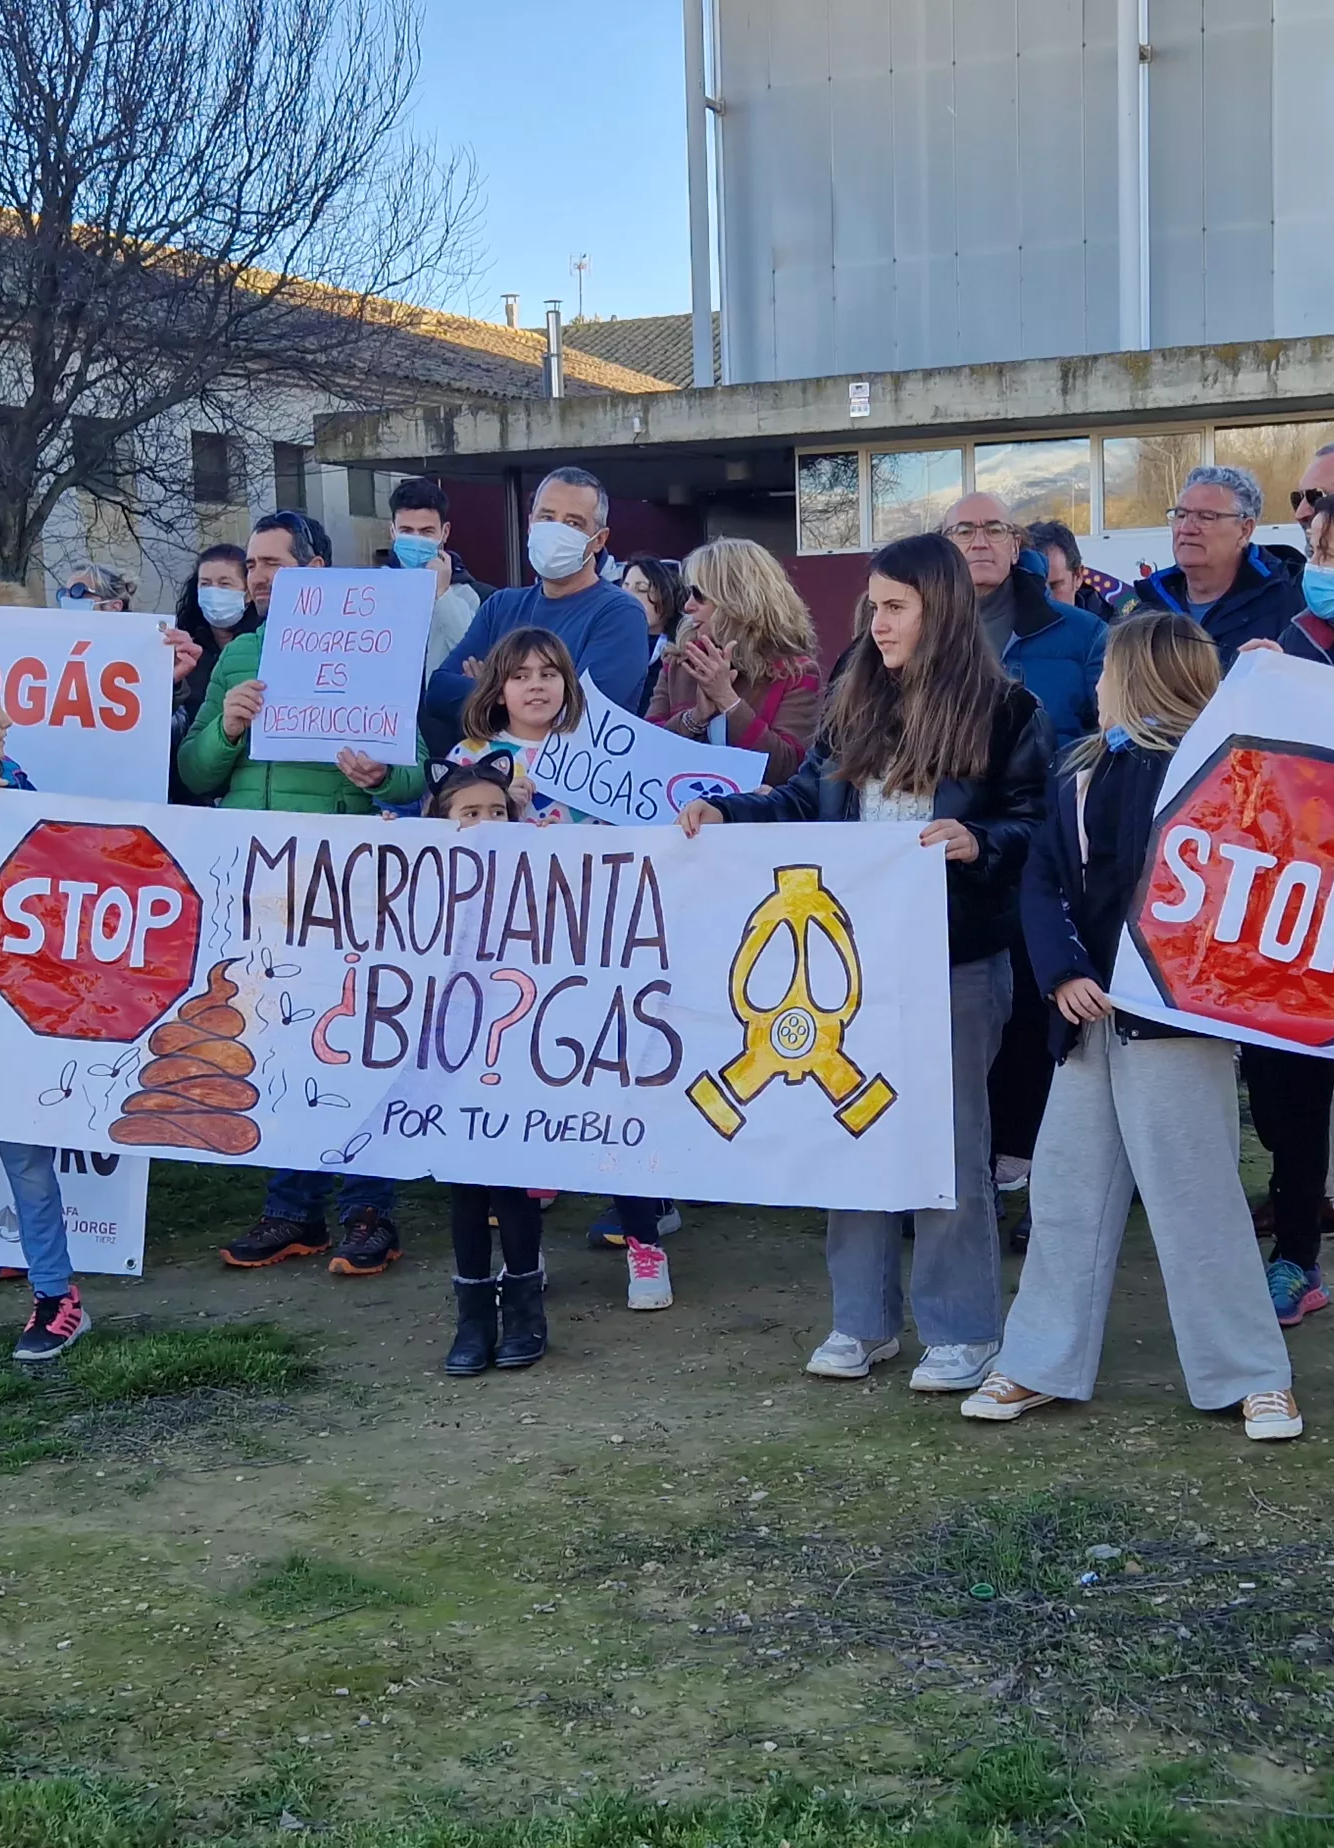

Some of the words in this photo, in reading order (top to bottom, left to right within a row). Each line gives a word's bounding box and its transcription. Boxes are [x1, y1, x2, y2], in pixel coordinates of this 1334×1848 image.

[293, 586, 323, 616] NO
[342, 586, 376, 617] ES
[280, 628, 392, 653] PROGRESO
[316, 663, 348, 687] ES
[263, 705, 398, 737] DESTRUCCIÓN
[585, 698, 636, 756] NO
[535, 733, 663, 820] BIOGAS
[243, 836, 669, 969] MACROPLANTA
[2, 876, 183, 969] STOP
[383, 1100, 446, 1137] POR
[460, 1107, 509, 1140] TU
[524, 1109, 645, 1146] PUEBLO
[72, 1220, 117, 1235] JORGE
